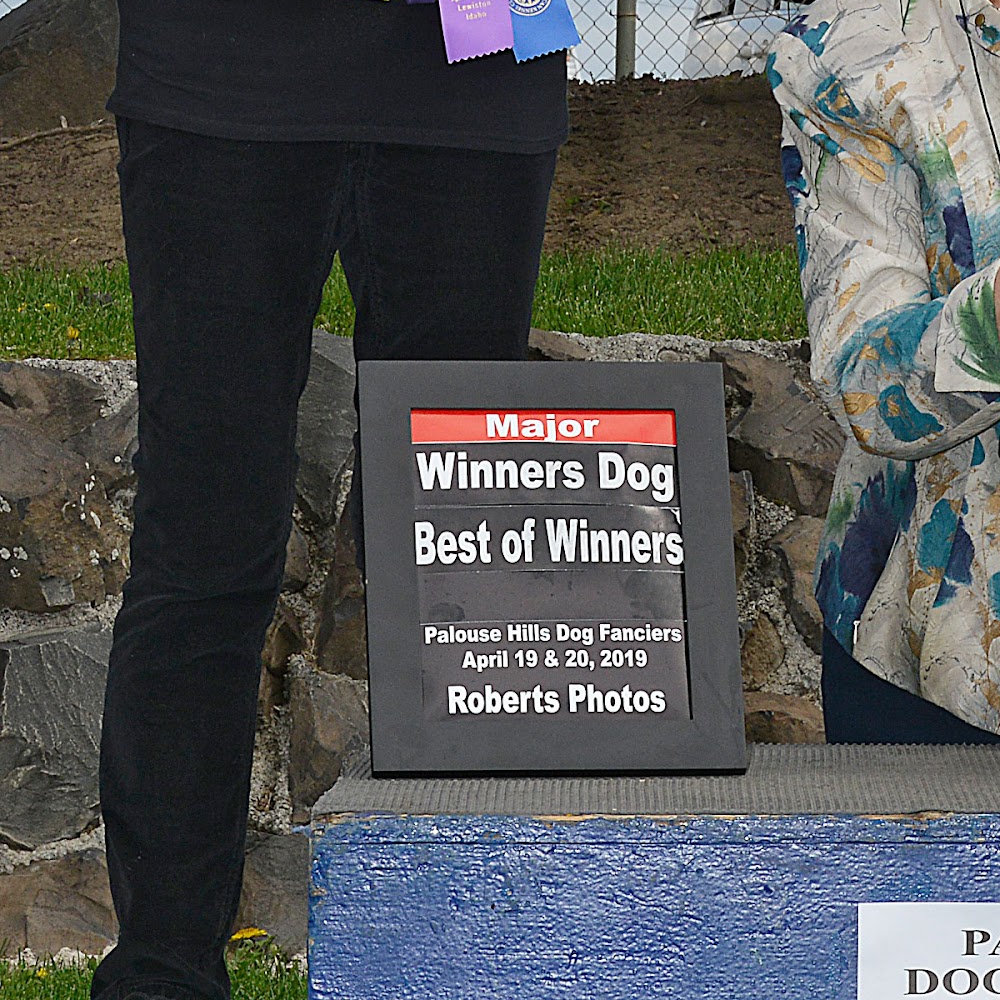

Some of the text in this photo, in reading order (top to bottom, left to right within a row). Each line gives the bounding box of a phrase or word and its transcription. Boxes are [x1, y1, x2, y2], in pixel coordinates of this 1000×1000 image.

[457, 1, 492, 12] Lewiston
[465, 11, 487, 21] Idaho
[486, 414, 600, 442] Major
[416, 451, 675, 503] Winners Dog
[415, 518, 684, 566] Best of Winners
[424, 624, 683, 646] Palouse Hills Dog Fanciers
[462, 650, 648, 673] April 19 & 20, 2019
[447, 683, 666, 714] Roberts Photos
